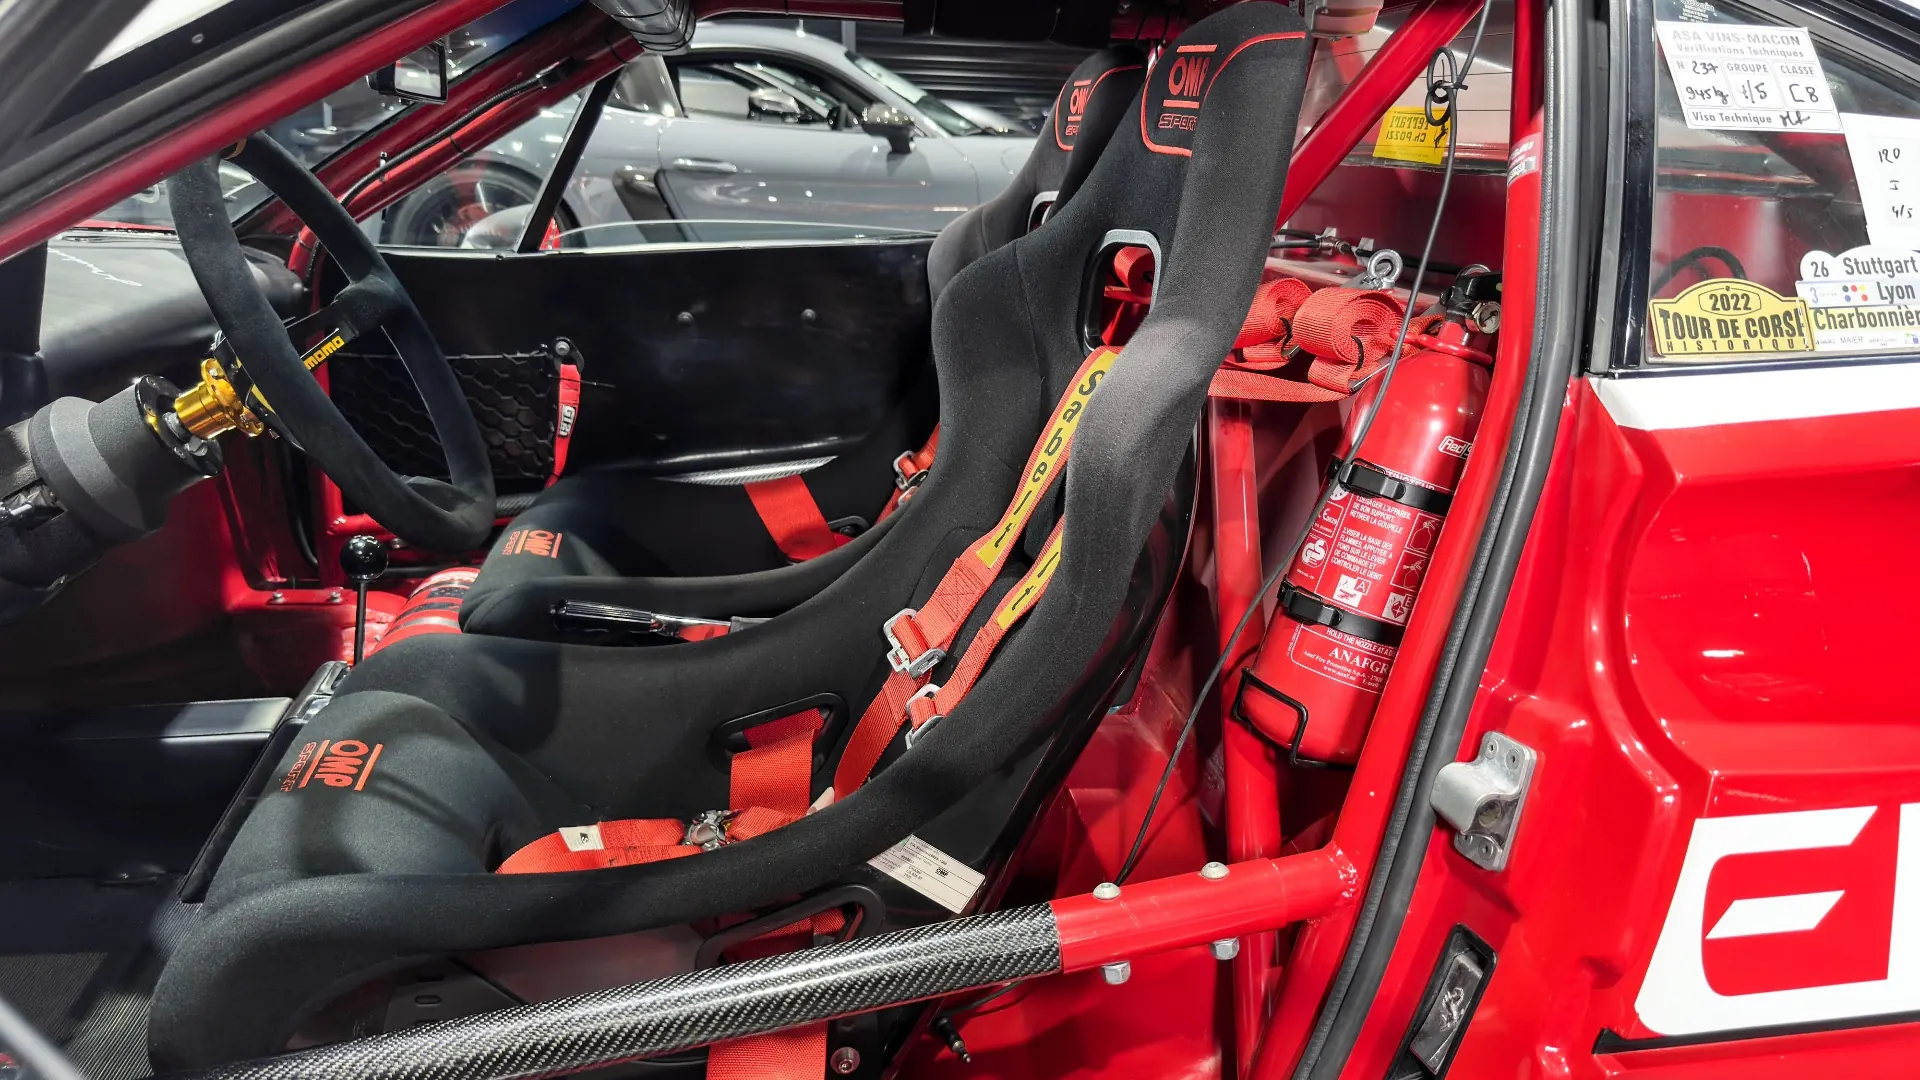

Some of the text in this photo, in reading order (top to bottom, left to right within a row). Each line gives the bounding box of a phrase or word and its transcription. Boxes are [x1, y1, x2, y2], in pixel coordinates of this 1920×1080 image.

[1673, 30, 1800, 46] ASA VINS-MACON
[1748, 46, 1804, 59] Techniques
[1692, 60, 1718, 75] 237
[1726, 62, 1768, 73] GROUPE
[1780, 65, 1815, 75] CLASSE
[1692, 112, 1716, 122] Visa
[1718, 112, 1772, 125] Technique
[1810, 256, 1919, 278] 26 Stuttgart
[1876, 281, 1916, 304] Lyon
[1708, 294, 1752, 311] 2022
[1658, 308, 1713, 340] TOUR
[1716, 318, 1742, 339] DE
[1360, 505, 1370, 514] SON
[1350, 510, 1370, 522] RETIRER
[1378, 520, 1404, 534] GOUPILLE
[524, 530, 554, 556] OMP
[1360, 534, 1368, 542] LA
[1367, 536, 1382, 546] BASE
[1382, 542, 1392, 550] DES
[1337, 542, 1387, 565] FOND SUR LE LEVIER
[1362, 544, 1388, 558] APPUYER
[1340, 552, 1370, 567] COMMANDE
[1369, 562, 1376, 570] ET
[1360, 568, 1368, 576] LE
[1354, 580, 1366, 592] A
[1326, 628, 1342, 640] HOLD
[1343, 634, 1356, 644] THE
[1354, 640, 1378, 652] NOZZLE
[1376, 647, 1385, 655] AT
[1316, 655, 1326, 664] Fire
[1326, 660, 1352, 673] Protection
[314, 740, 370, 787] OMP
